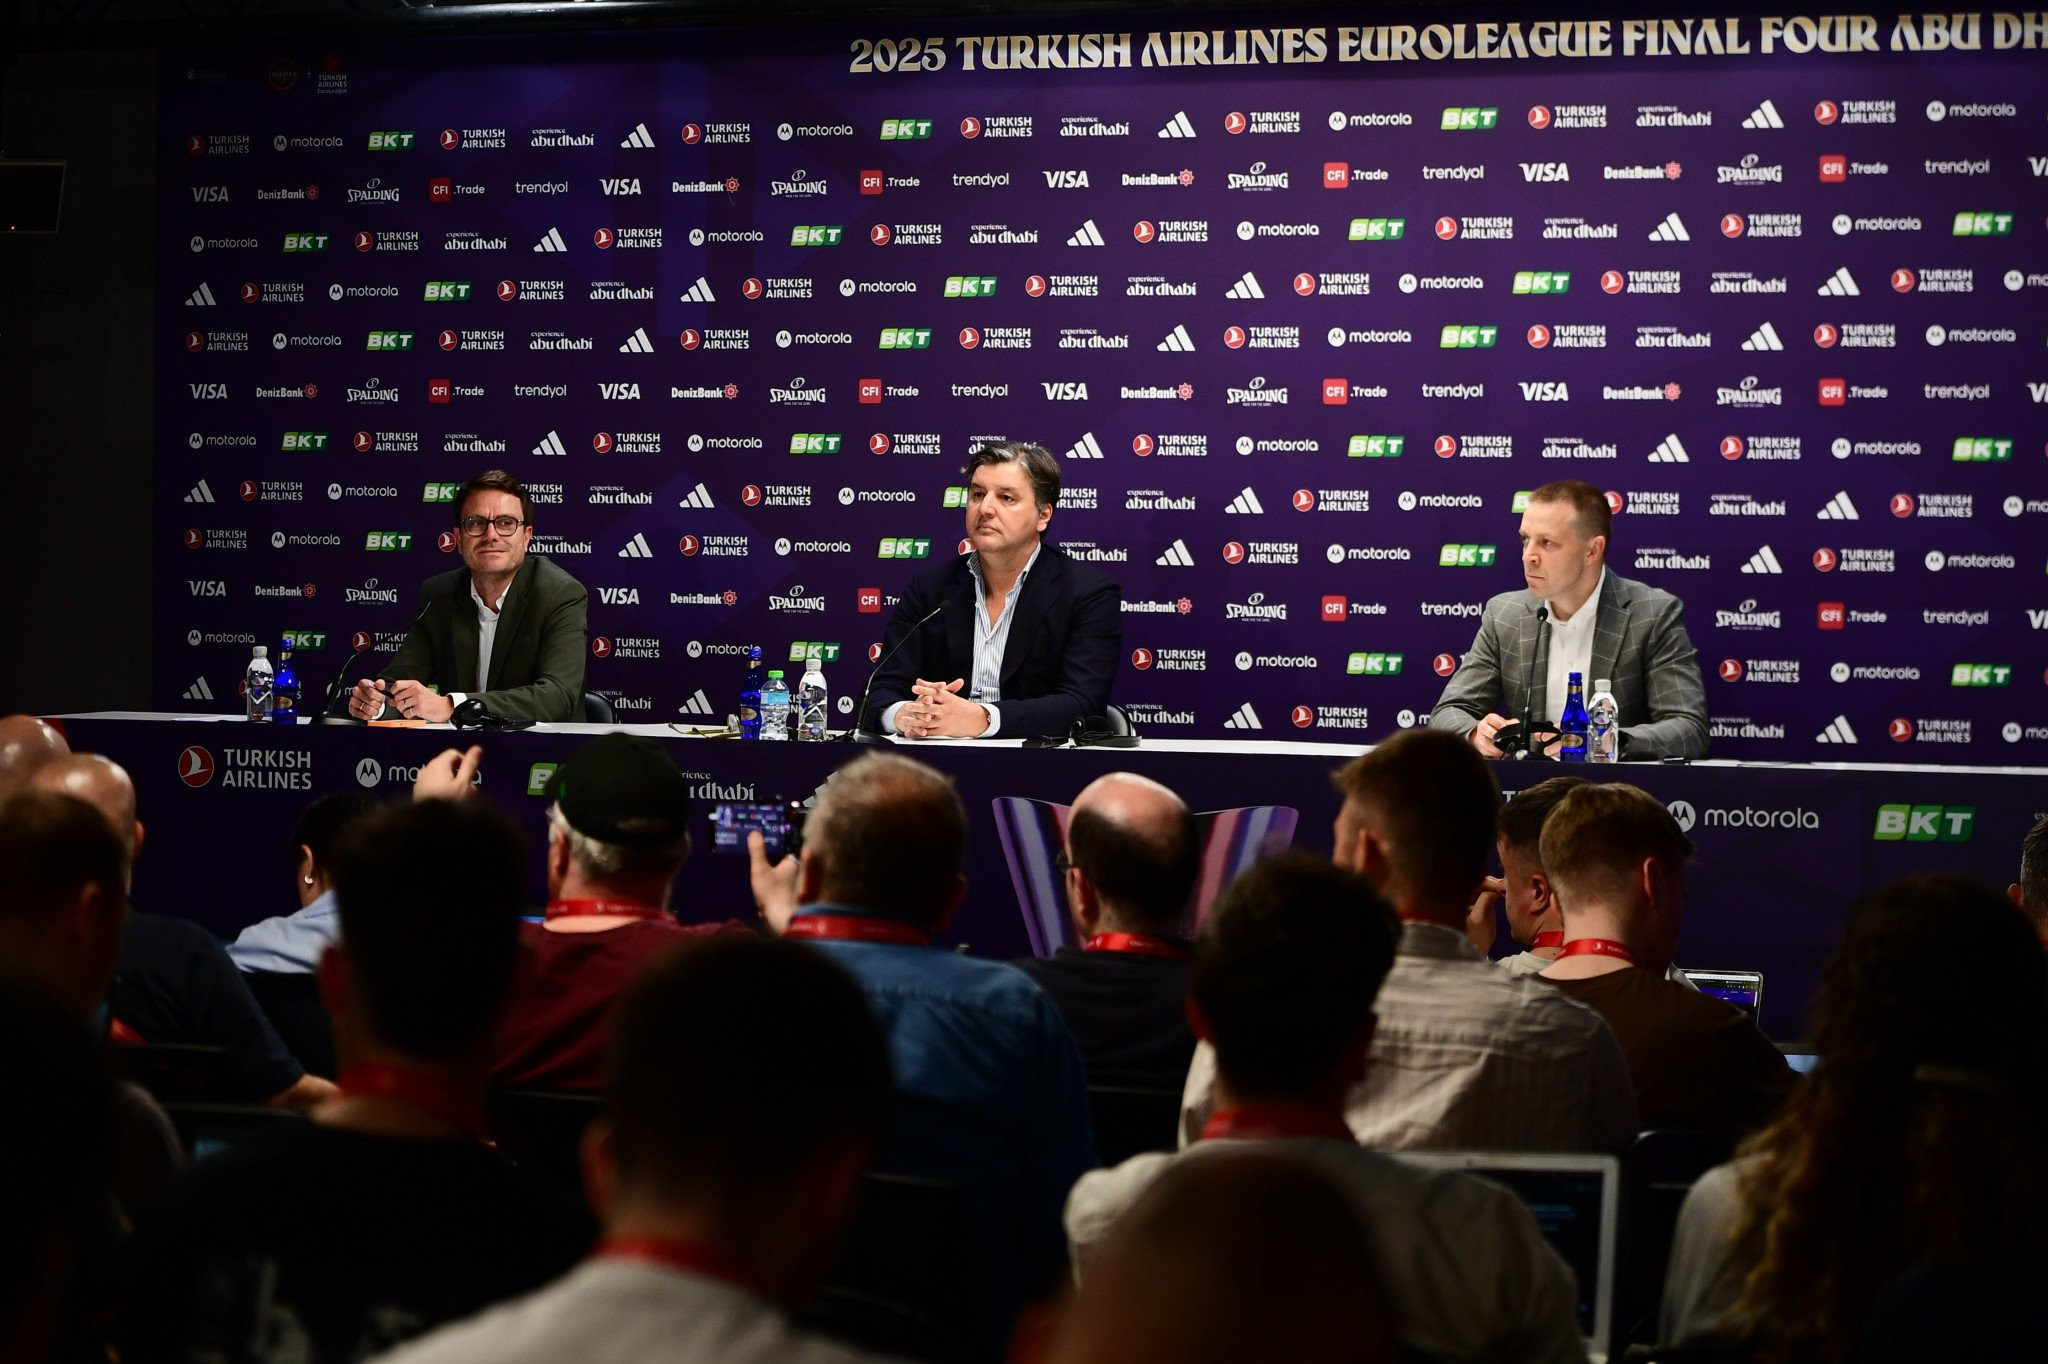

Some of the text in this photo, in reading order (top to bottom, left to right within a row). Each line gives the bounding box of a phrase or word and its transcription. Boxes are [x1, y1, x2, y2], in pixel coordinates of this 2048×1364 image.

[850, 38, 946, 73] 2025
[956, 34, 1132, 70] TURKISH
[1141, 28, 1327, 67] AIRLINES
[1338, 21, 1612, 62] EUROLEAGUE
[1622, 18, 1750, 56] FINAL
[1760, 16, 1880, 54] FOUR
[1890, 14, 1981, 51] ABU
[1555, 106, 1606, 116] TURKISH
[1443, 112, 1496, 125] BKT
[1554, 116, 1607, 128] AIRLINES
[463, 129, 505, 138] TURKISH
[882, 123, 930, 136] BKT
[1060, 123, 1086, 136] abu
[370, 135, 412, 146] BKT
[462, 139, 505, 148] AIRLINES
[531, 136, 555, 146] abu
[1423, 165, 1484, 181] trendyol
[1519, 163, 1569, 181] VISA
[1925, 160, 1990, 175] trendyol
[953, 173, 1009, 187] trendyol
[1042, 171, 1089, 188] VISA
[1122, 174, 1179, 185] DenizBank
[1327, 170, 1345, 180] CFI
[673, 181, 728, 192] DenizBank
[864, 178, 879, 187] CFI
[1228, 173, 1288, 189] SPALDING
[433, 186, 447, 194] CFI
[516, 181, 568, 195] trendyol
[600, 179, 641, 195] VISA
[772, 180, 826, 195] SPALDING
[258, 189, 304, 199] DenizBank
[348, 188, 399, 202] SPALDING
[895, 224, 941, 234] TURKISH
[1159, 221, 1207, 231] TURKISH
[1855, 217, 1921, 230] motorola
[1258, 223, 1319, 236] motorola
[1350, 223, 1403, 236] BKT
[708, 230, 763, 241] motorola
[793, 229, 840, 242] BKT
[894, 235, 941, 244] AIRLINES
[1158, 232, 1208, 242] AIRLINES
[520, 281, 563, 289] TURKISH
[767, 279, 811, 288] TURKISH
[859, 281, 916, 292] motorola
[945, 280, 995, 293] BKT
[1127, 282, 1153, 296] abu
[347, 286, 398, 296] motorola
[426, 285, 469, 297] BKT
[519, 291, 564, 299] AIRLINES
[590, 288, 614, 299] abu
[766, 289, 812, 298] AIRLINES
[461, 331, 503, 339] TURKISH
[704, 330, 748, 338] TURKISH
[1349, 330, 1411, 342] motorola
[1554, 325, 1606, 336] TURKISH
[1949, 329, 2016, 341] motorola
[291, 335, 341, 345] motorola
[368, 335, 411, 346] BKT
[796, 332, 851, 343] motorola
[1442, 330, 1495, 343] BKT
[1553, 336, 1606, 347] AIRLINES
[461, 341, 504, 349] AIRLINES
[704, 340, 749, 349] AIRLINES
[189, 384, 227, 399] VISA
[257, 388, 303, 397] DenizBank
[347, 388, 398, 402] SPALDING
[432, 387, 447, 395] CFI
[515, 385, 566, 398] trendyol
[598, 383, 640, 399] VISA
[672, 387, 726, 398] DenizBank
[770, 388, 825, 402] SPALDING
[862, 387, 878, 396] CFI
[952, 384, 1008, 398] trendyol
[1041, 383, 1088, 400] VISA
[1121, 387, 1178, 398] DenizBank
[1227, 388, 1287, 404] SPALDING
[1326, 387, 1344, 397] CFI
[1422, 384, 1483, 399] trendyol
[1518, 382, 1568, 401] VISA
[1822, 387, 1842, 398] CFI
[283, 436, 326, 447] BKT
[707, 437, 762, 448] motorola
[791, 437, 839, 449] BKT
[894, 434, 940, 443] TURKISH
[1158, 435, 1206, 445] TURKISH
[893, 445, 940, 454] AIRLINES
[1257, 439, 1318, 451] motorola
[1349, 440, 1402, 453] BKT
[1854, 442, 1921, 454] motorola
[1954, 442, 2010, 457] BKT
[1157, 446, 1207, 456] AIRLINES
[346, 486, 397, 496] motorola
[765, 486, 810, 495] TURKISH
[859, 490, 915, 501] motorola
[589, 492, 613, 503] abu
[765, 497, 811, 505] AIRLINES
[1420, 495, 1482, 507] motorola
[289, 534, 340, 545] motorola
[367, 536, 410, 547] BKT
[795, 541, 850, 552] motorola
[880, 542, 928, 554] BKT
[1248, 543, 1298, 553] TURKISH
[1248, 554, 1298, 564] AIRLINES
[1348, 547, 1410, 560] motorola
[1441, 548, 1494, 562] BKT
[188, 581, 226, 596] VISA
[255, 586, 302, 596] DenizBank
[346, 589, 396, 602] SPALDING
[597, 588, 639, 604] VISA
[671, 593, 721, 604] DenizBank
[861, 596, 877, 605] CFI
[769, 596, 824, 611] SPALDING
[1121, 601, 1178, 612] DenizBank
[1325, 603, 1343, 613] CFI
[1226, 604, 1286, 619] SPALDING
[1421, 602, 1482, 619] trendyol
[1716, 611, 1780, 628] SPALDING
[791, 646, 838, 657] BKT
[1157, 650, 1205, 659] TURKISH
[1157, 660, 1206, 670] AIRLINES
[1256, 655, 1317, 667] motorola
[1348, 657, 1401, 671] BKT
[1953, 668, 2008, 682] BKT
[224, 749, 310, 768] TURKISH
[223, 770, 311, 789] AIRLINES
[1705, 807, 1818, 828] motorola
[1878, 811, 1971, 834] BKT
